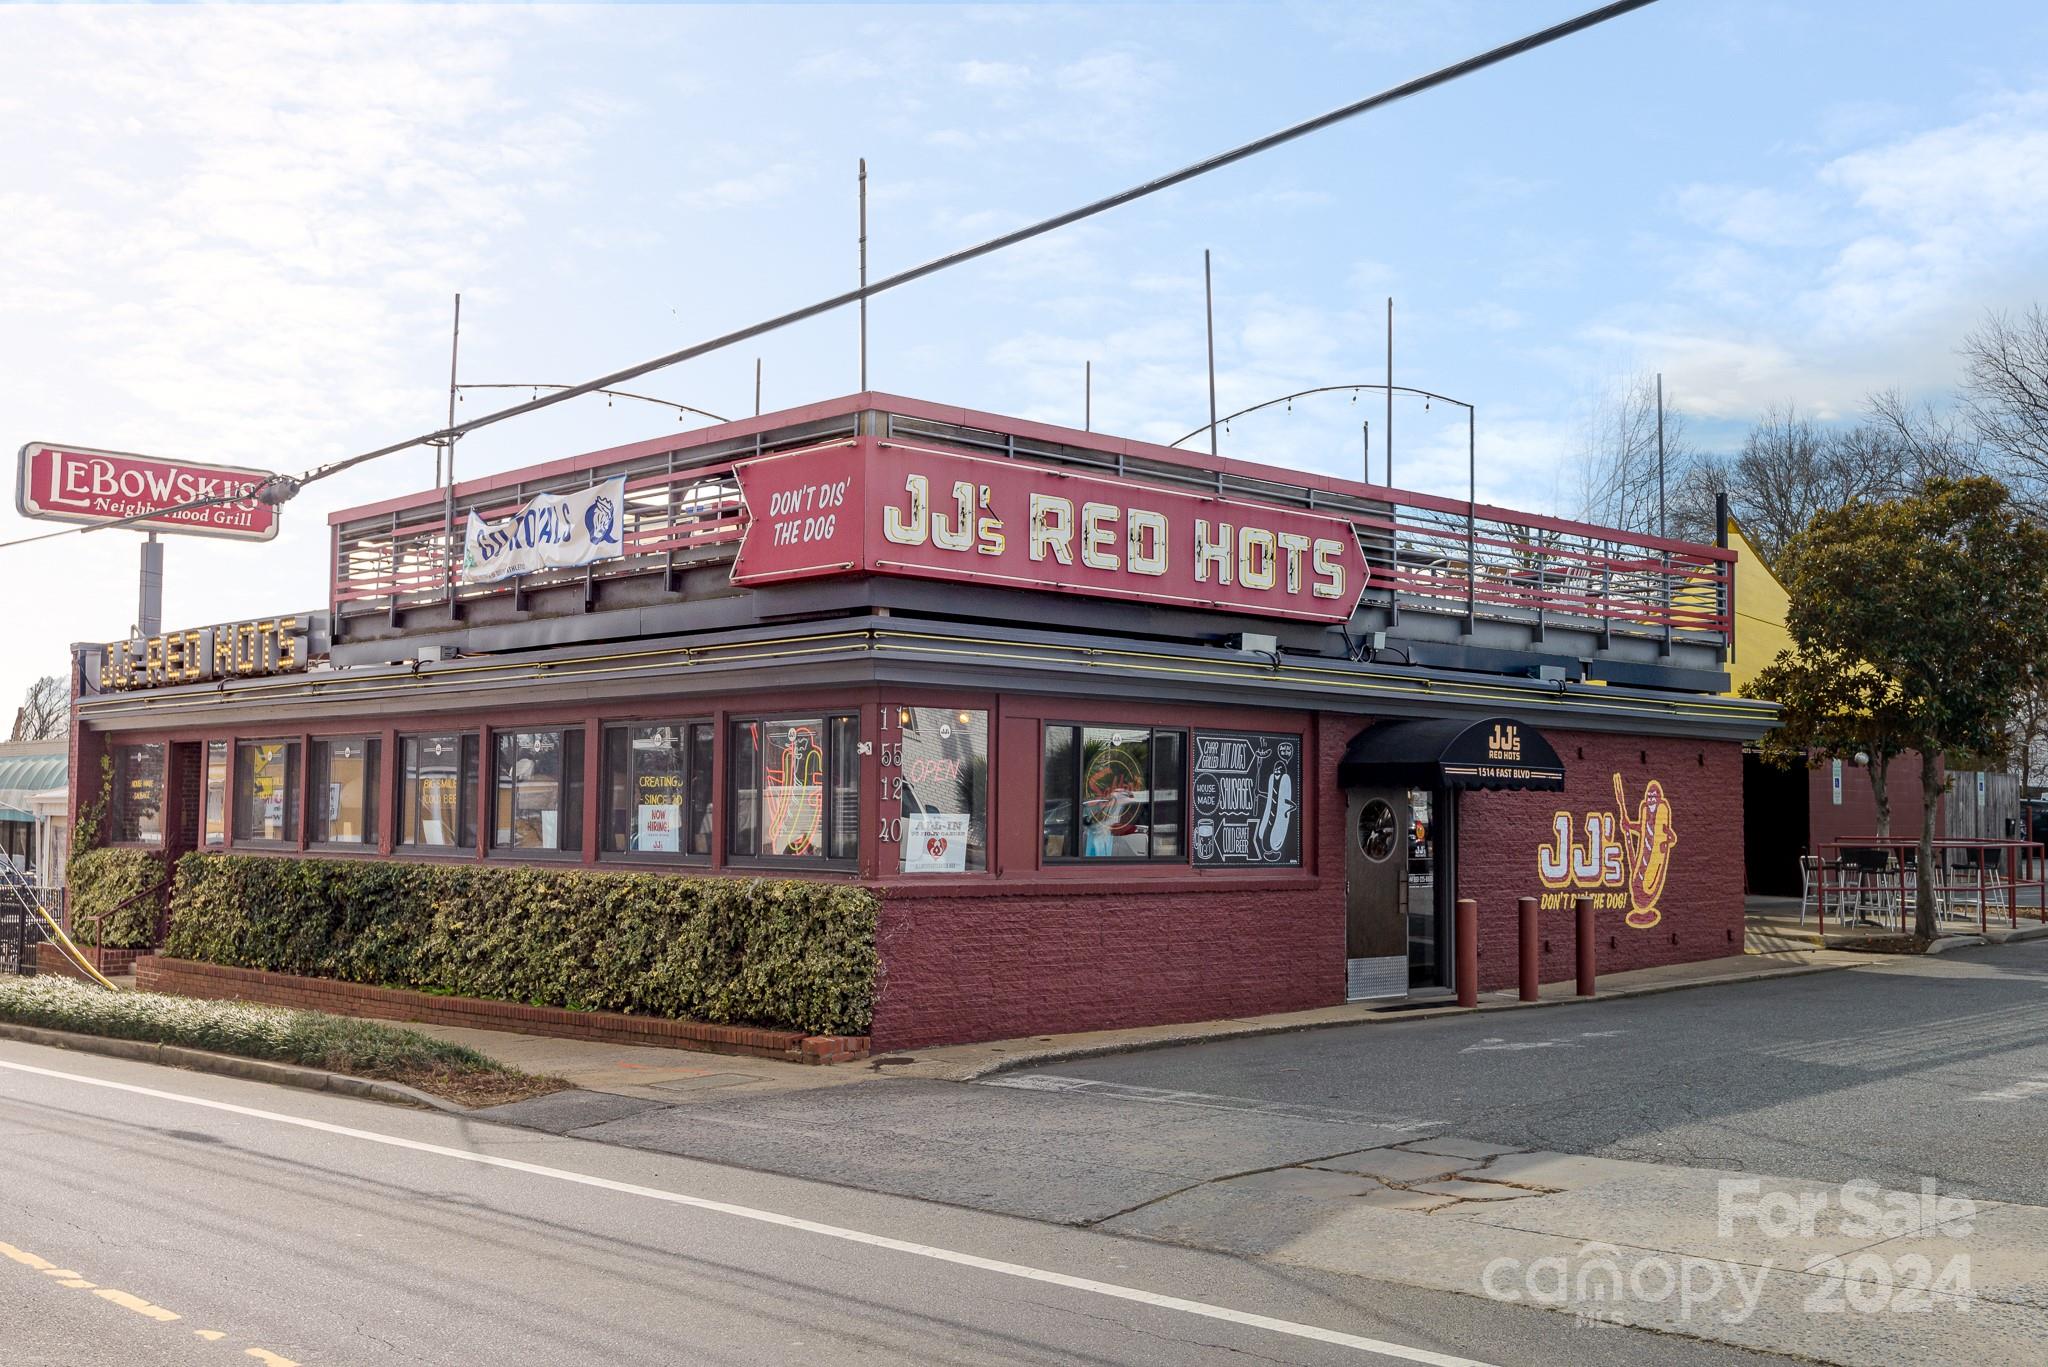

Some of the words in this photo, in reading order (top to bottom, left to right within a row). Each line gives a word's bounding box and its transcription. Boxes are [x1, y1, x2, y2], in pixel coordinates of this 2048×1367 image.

[770, 484, 817, 517] DON'T
[818, 475, 851, 509] DIS'
[93, 497, 210, 521] Neighbhood
[213, 510, 253, 527] Grill
[774, 519, 802, 547] THE
[803, 514, 836, 543] DOG
[1028, 492, 1170, 576] RED
[1194, 517, 1346, 599] HOTS
[146, 631, 201, 685] RED
[214, 616, 300, 673] HOTS
[1203, 741, 1219, 755] CHAR
[1220, 742, 1232, 769] HOT
[1488, 750, 1503, 760] RED
[1503, 751, 1521, 761] HOTS
[911, 756, 960, 783] OPEN
[1478, 767, 1495, 778] 1514
[1513, 769, 1530, 779] BLVD
[1196, 784, 1216, 793] HOUSE
[1197, 796, 1216, 806] MADE
[651, 809, 667, 820] NOW
[1222, 826, 1236, 853] COLD
[1235, 839, 1249, 853] BEER
[1539, 812, 1623, 887] JJ's
[1541, 891, 1570, 910] DON'T
[1606, 892, 1628, 909] DOG!
